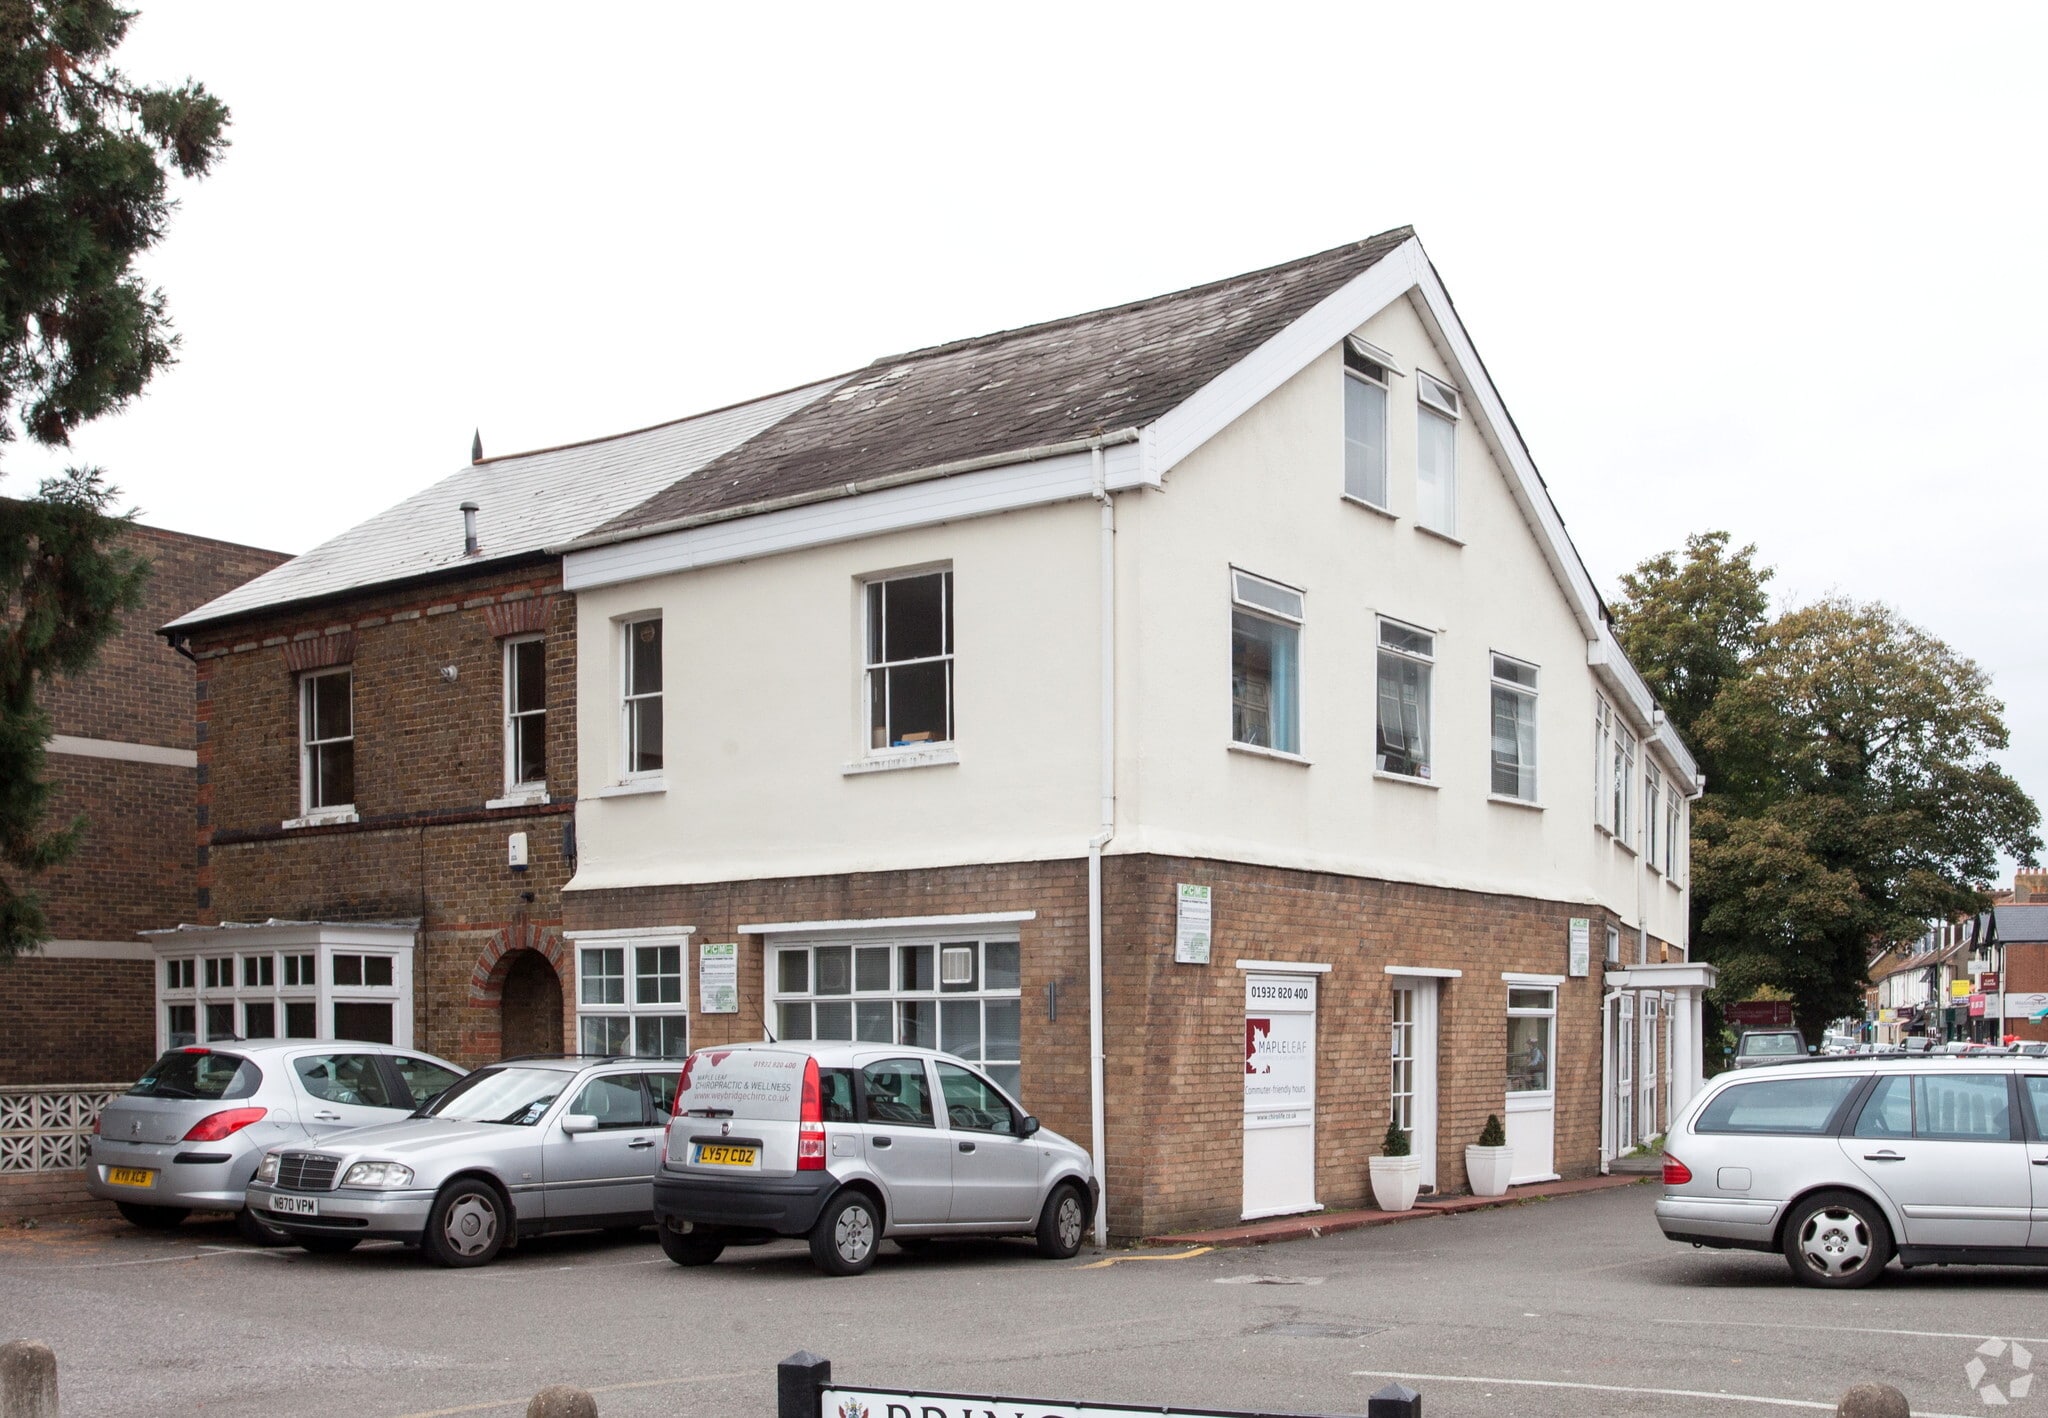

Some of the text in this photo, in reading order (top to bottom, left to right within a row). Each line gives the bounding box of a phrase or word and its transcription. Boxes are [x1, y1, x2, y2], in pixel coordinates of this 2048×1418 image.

[1251, 986, 1308, 1000] 01932 820 400
[695, 1081, 791, 1092] CHIROPRACTIC & WELLNESS
[1292, 1085, 1306, 1093] hours
[694, 1091, 790, 1102] www.weybridgechiro.co.uk
[701, 1146, 754, 1163] LY57 CDZ
[130, 1170, 147, 1183] XCB
[274, 1196, 314, 1213] N870 VPM
